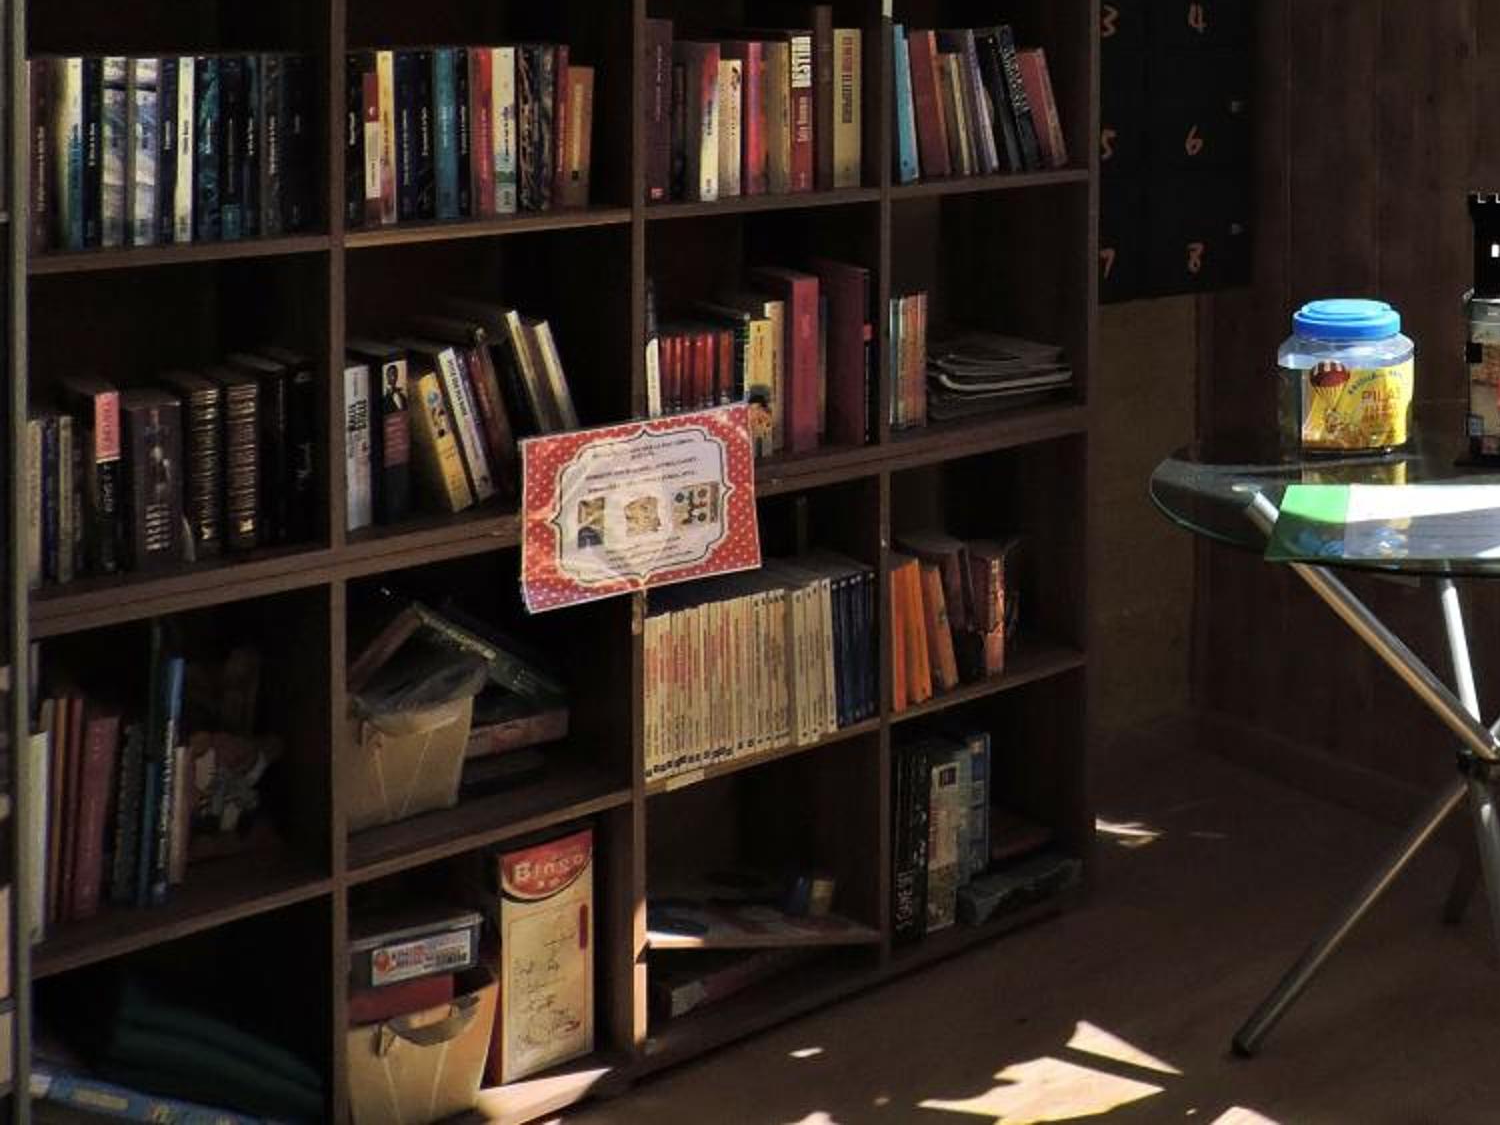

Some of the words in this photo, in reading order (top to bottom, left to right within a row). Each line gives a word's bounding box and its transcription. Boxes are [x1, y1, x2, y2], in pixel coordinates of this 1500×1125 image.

[1101, 4, 1119, 38] 3
[1187, 0, 1208, 34] 4
[1101, 127, 1118, 160] 5
[1184, 124, 1204, 156] 6
[1100, 246, 1116, 281] 7
[1186, 241, 1207, 275] 8
